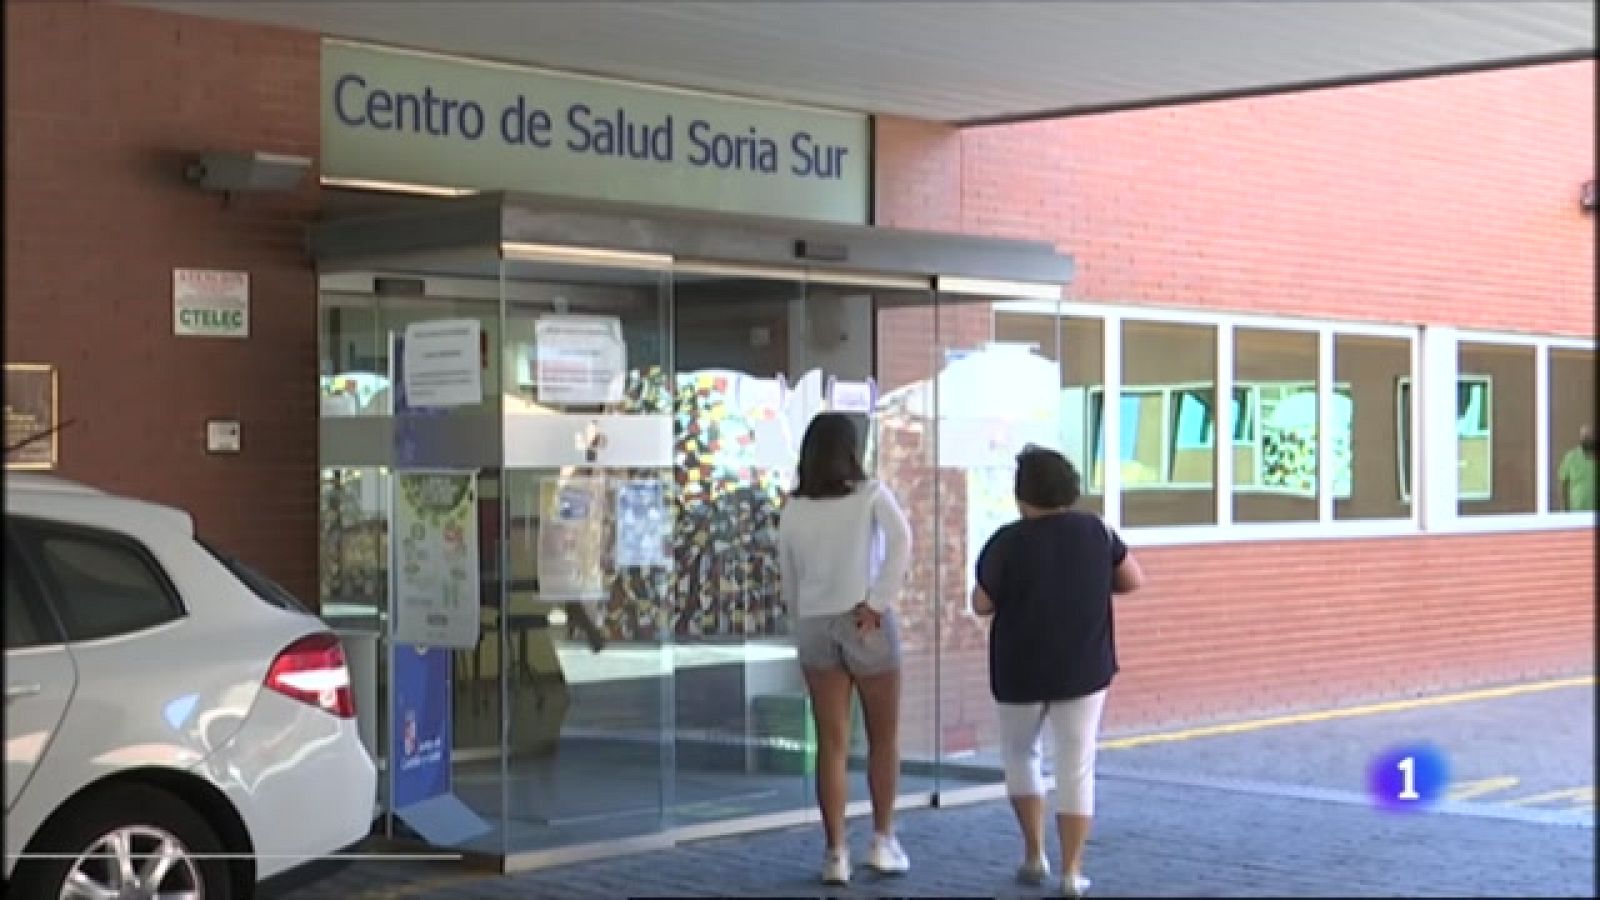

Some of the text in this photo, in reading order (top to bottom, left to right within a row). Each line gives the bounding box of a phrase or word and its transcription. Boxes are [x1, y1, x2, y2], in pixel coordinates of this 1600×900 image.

[334, 73, 849, 179] Centro de Salud Soria Sur
